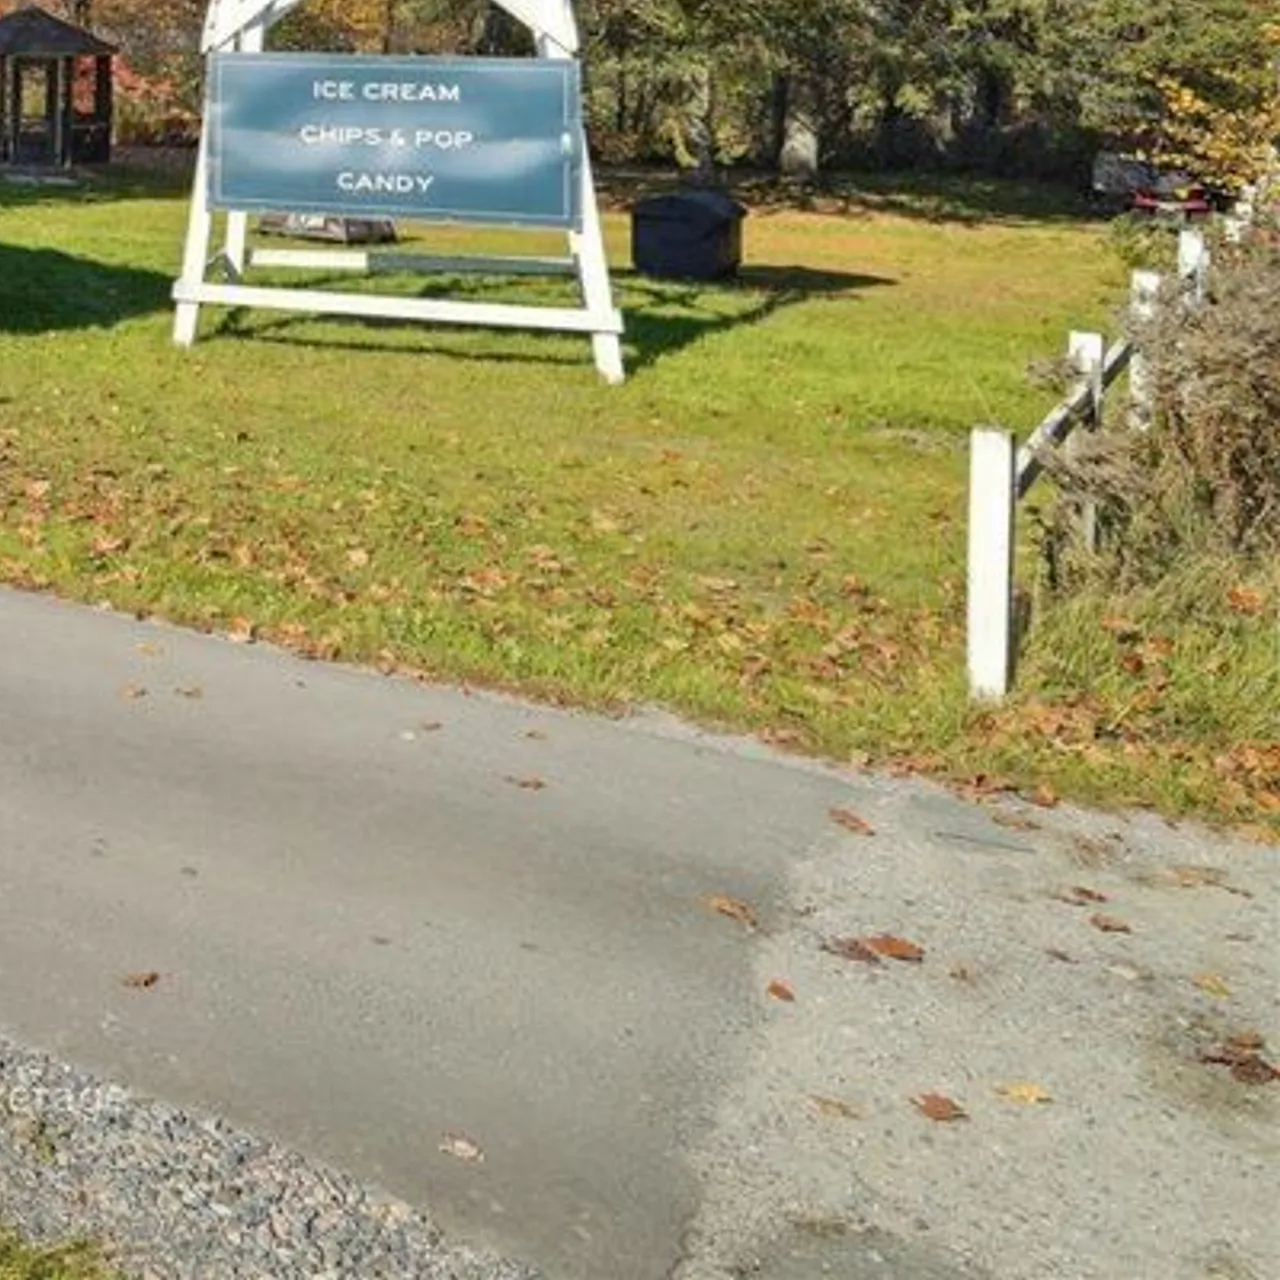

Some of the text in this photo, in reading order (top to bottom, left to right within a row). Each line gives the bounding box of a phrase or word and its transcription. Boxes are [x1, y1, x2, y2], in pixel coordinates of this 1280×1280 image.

[313, 81, 461, 102] ICE CREAM
[300, 124, 473, 150] CHIPS & POP
[336, 172, 434, 194] CANDY
